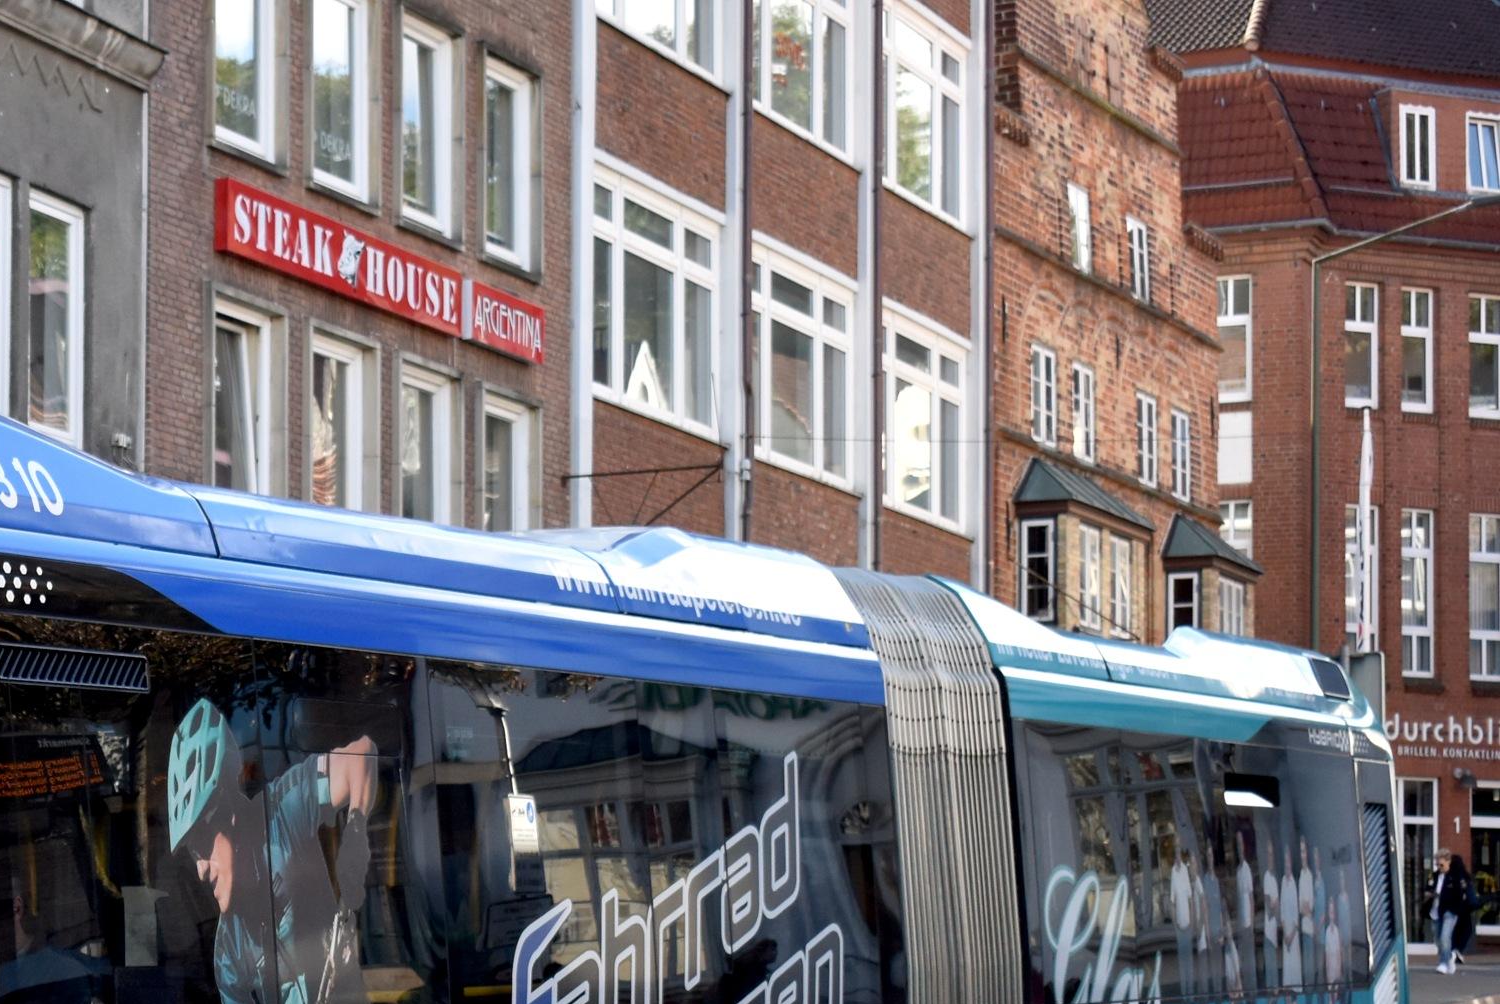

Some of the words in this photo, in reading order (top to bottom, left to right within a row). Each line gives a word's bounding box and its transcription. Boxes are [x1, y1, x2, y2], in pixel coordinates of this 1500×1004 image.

[223, 87, 256, 119] DEKRA
[320, 130, 351, 158] DEKRA
[234, 192, 333, 278] STEAK
[366, 244, 457, 325] HOUSE
[474, 294, 542, 358] ARGENTINA
[1453, 815, 1461, 834] 1
